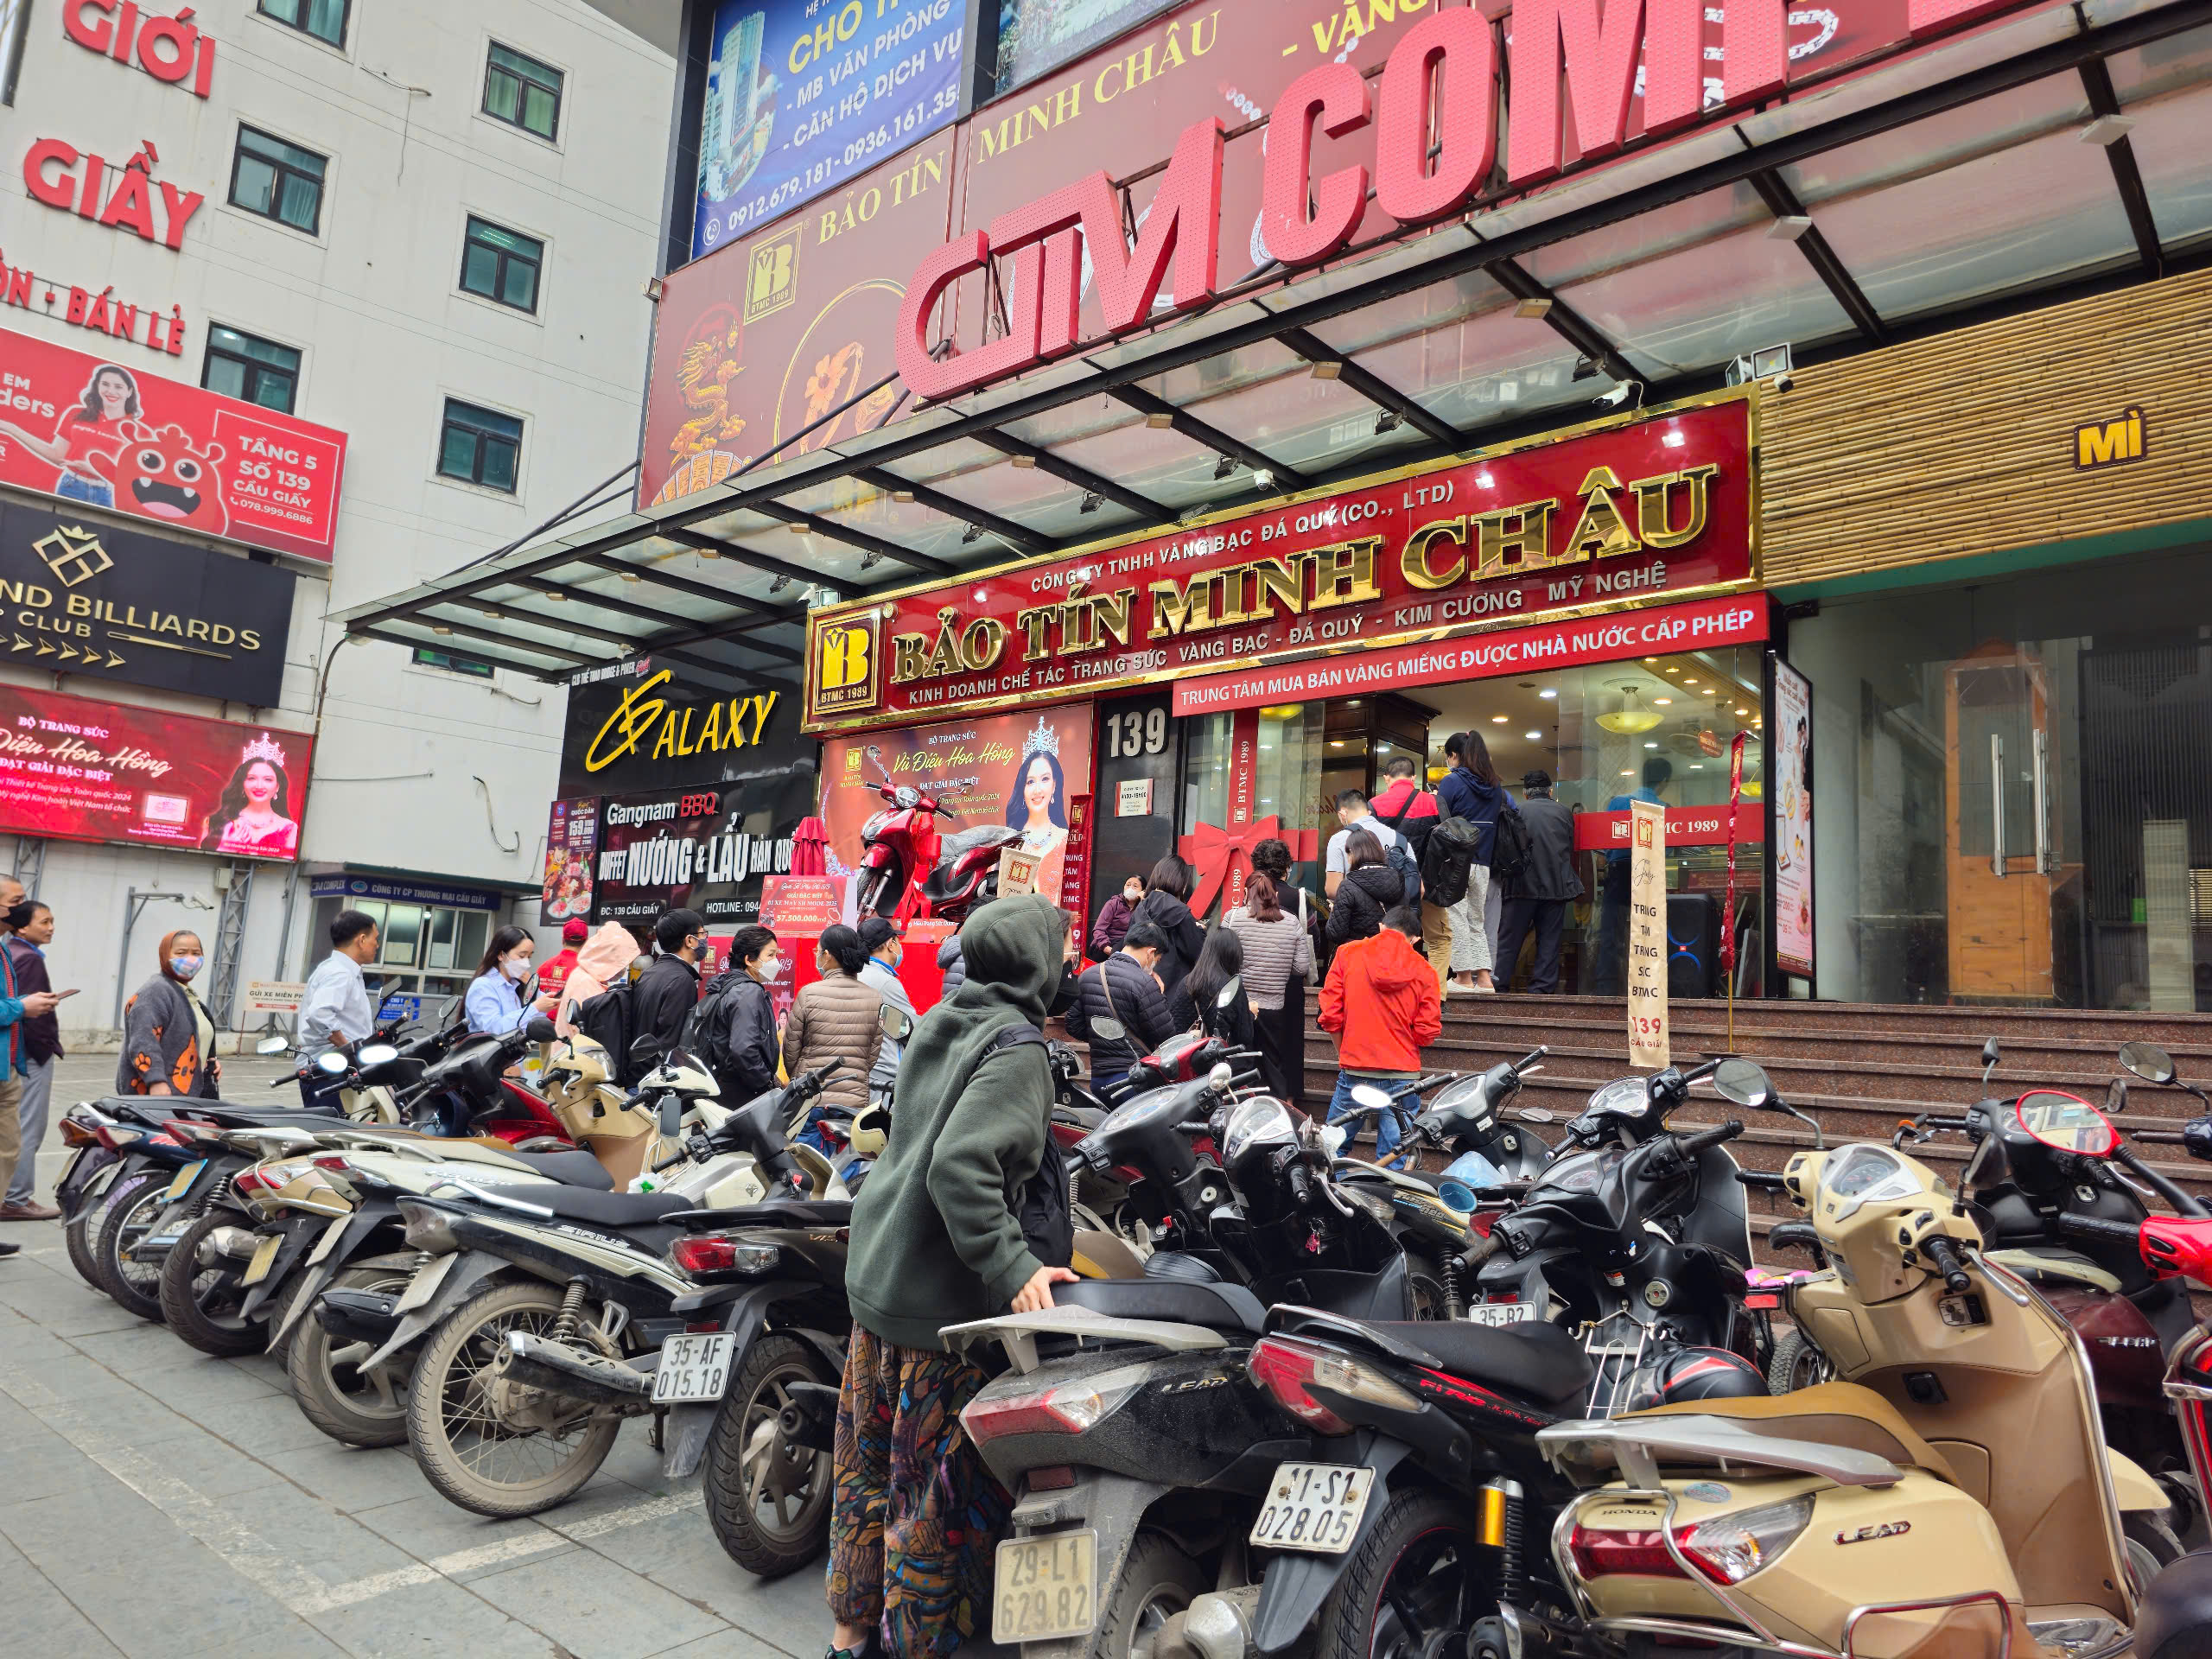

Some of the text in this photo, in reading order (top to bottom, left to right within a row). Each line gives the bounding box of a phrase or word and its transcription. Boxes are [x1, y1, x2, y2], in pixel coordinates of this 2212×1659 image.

[789, 0, 862, 73] CHO
[793, 27, 963, 148] CĂN HỘ DỊCH VỤ
[797, 76, 823, 110] MB
[830, 44, 868, 86] VĂN
[817, 10, 1221, 245] BẢO TÍN MINH CHÂU
[772, 289, 789, 306] 1989
[67, 285, 186, 356] BÁN LẺ
[238, 435, 317, 470] TẦNG 5
[238, 460, 311, 491] SỐ 139
[1031, 569, 1077, 594] CÔNG
[1085, 563, 1103, 581] TY
[1109, 551, 1154, 575] TNHH
[1160, 539, 1212, 563] VÀNG
[1214, 529, 1252, 551] BẠC
[1262, 518, 1287, 541] ĐÁ
[1403, 480, 1454, 510] LTD)
[890, 462, 1720, 684] BẢO TÍN MINH CHÂU
[17, 612, 92, 639] CLUB
[67, 592, 261, 651] BILLIARDS
[910, 560, 1668, 705] KINH DOANH CHẾ TÁC TRANG SỨC VÀNG BẠC ĐÁ QUÝ KIM CƯƠNG MỸ NGHỆ
[1181, 609, 1755, 708] TRUNG TÂM MUA BÁN VÀNG MIẾNG ĐƯỢC NHÀ NƯỚC CẤP PHÉP
[821, 684, 868, 704] BTMC 1989
[39, 719, 81, 734] TRANG
[586, 669, 778, 772] GALAXY
[939, 734, 962, 743] TRANG
[1107, 707, 1166, 758] 139
[945, 747, 976, 767] Hoa
[1237, 741, 1249, 803] BTMC 1989
[607, 791, 717, 828] Gangnam BBQ
[1687, 820, 1719, 833] 1989
[599, 850, 627, 880] BUFFET
[626, 830, 692, 887] NƯỚNG
[696, 845, 705, 873] &
[707, 812, 750, 883] LẨU
[403, 887, 412, 896] CP
[706, 901, 743, 913] HOTLINE:
[614, 906, 625, 916] 139
[1632, 986, 1658, 998] BTMC
[1631, 1016, 1661, 1033] 139
[671, 1338, 723, 1366] 35-AF
[658, 1368, 722, 1397] 015.18
[1256, 1505, 1354, 1545] 028.05
[1834, 1521, 1911, 1545] LEAD
[1011, 1538, 1079, 1586] 29-L1
